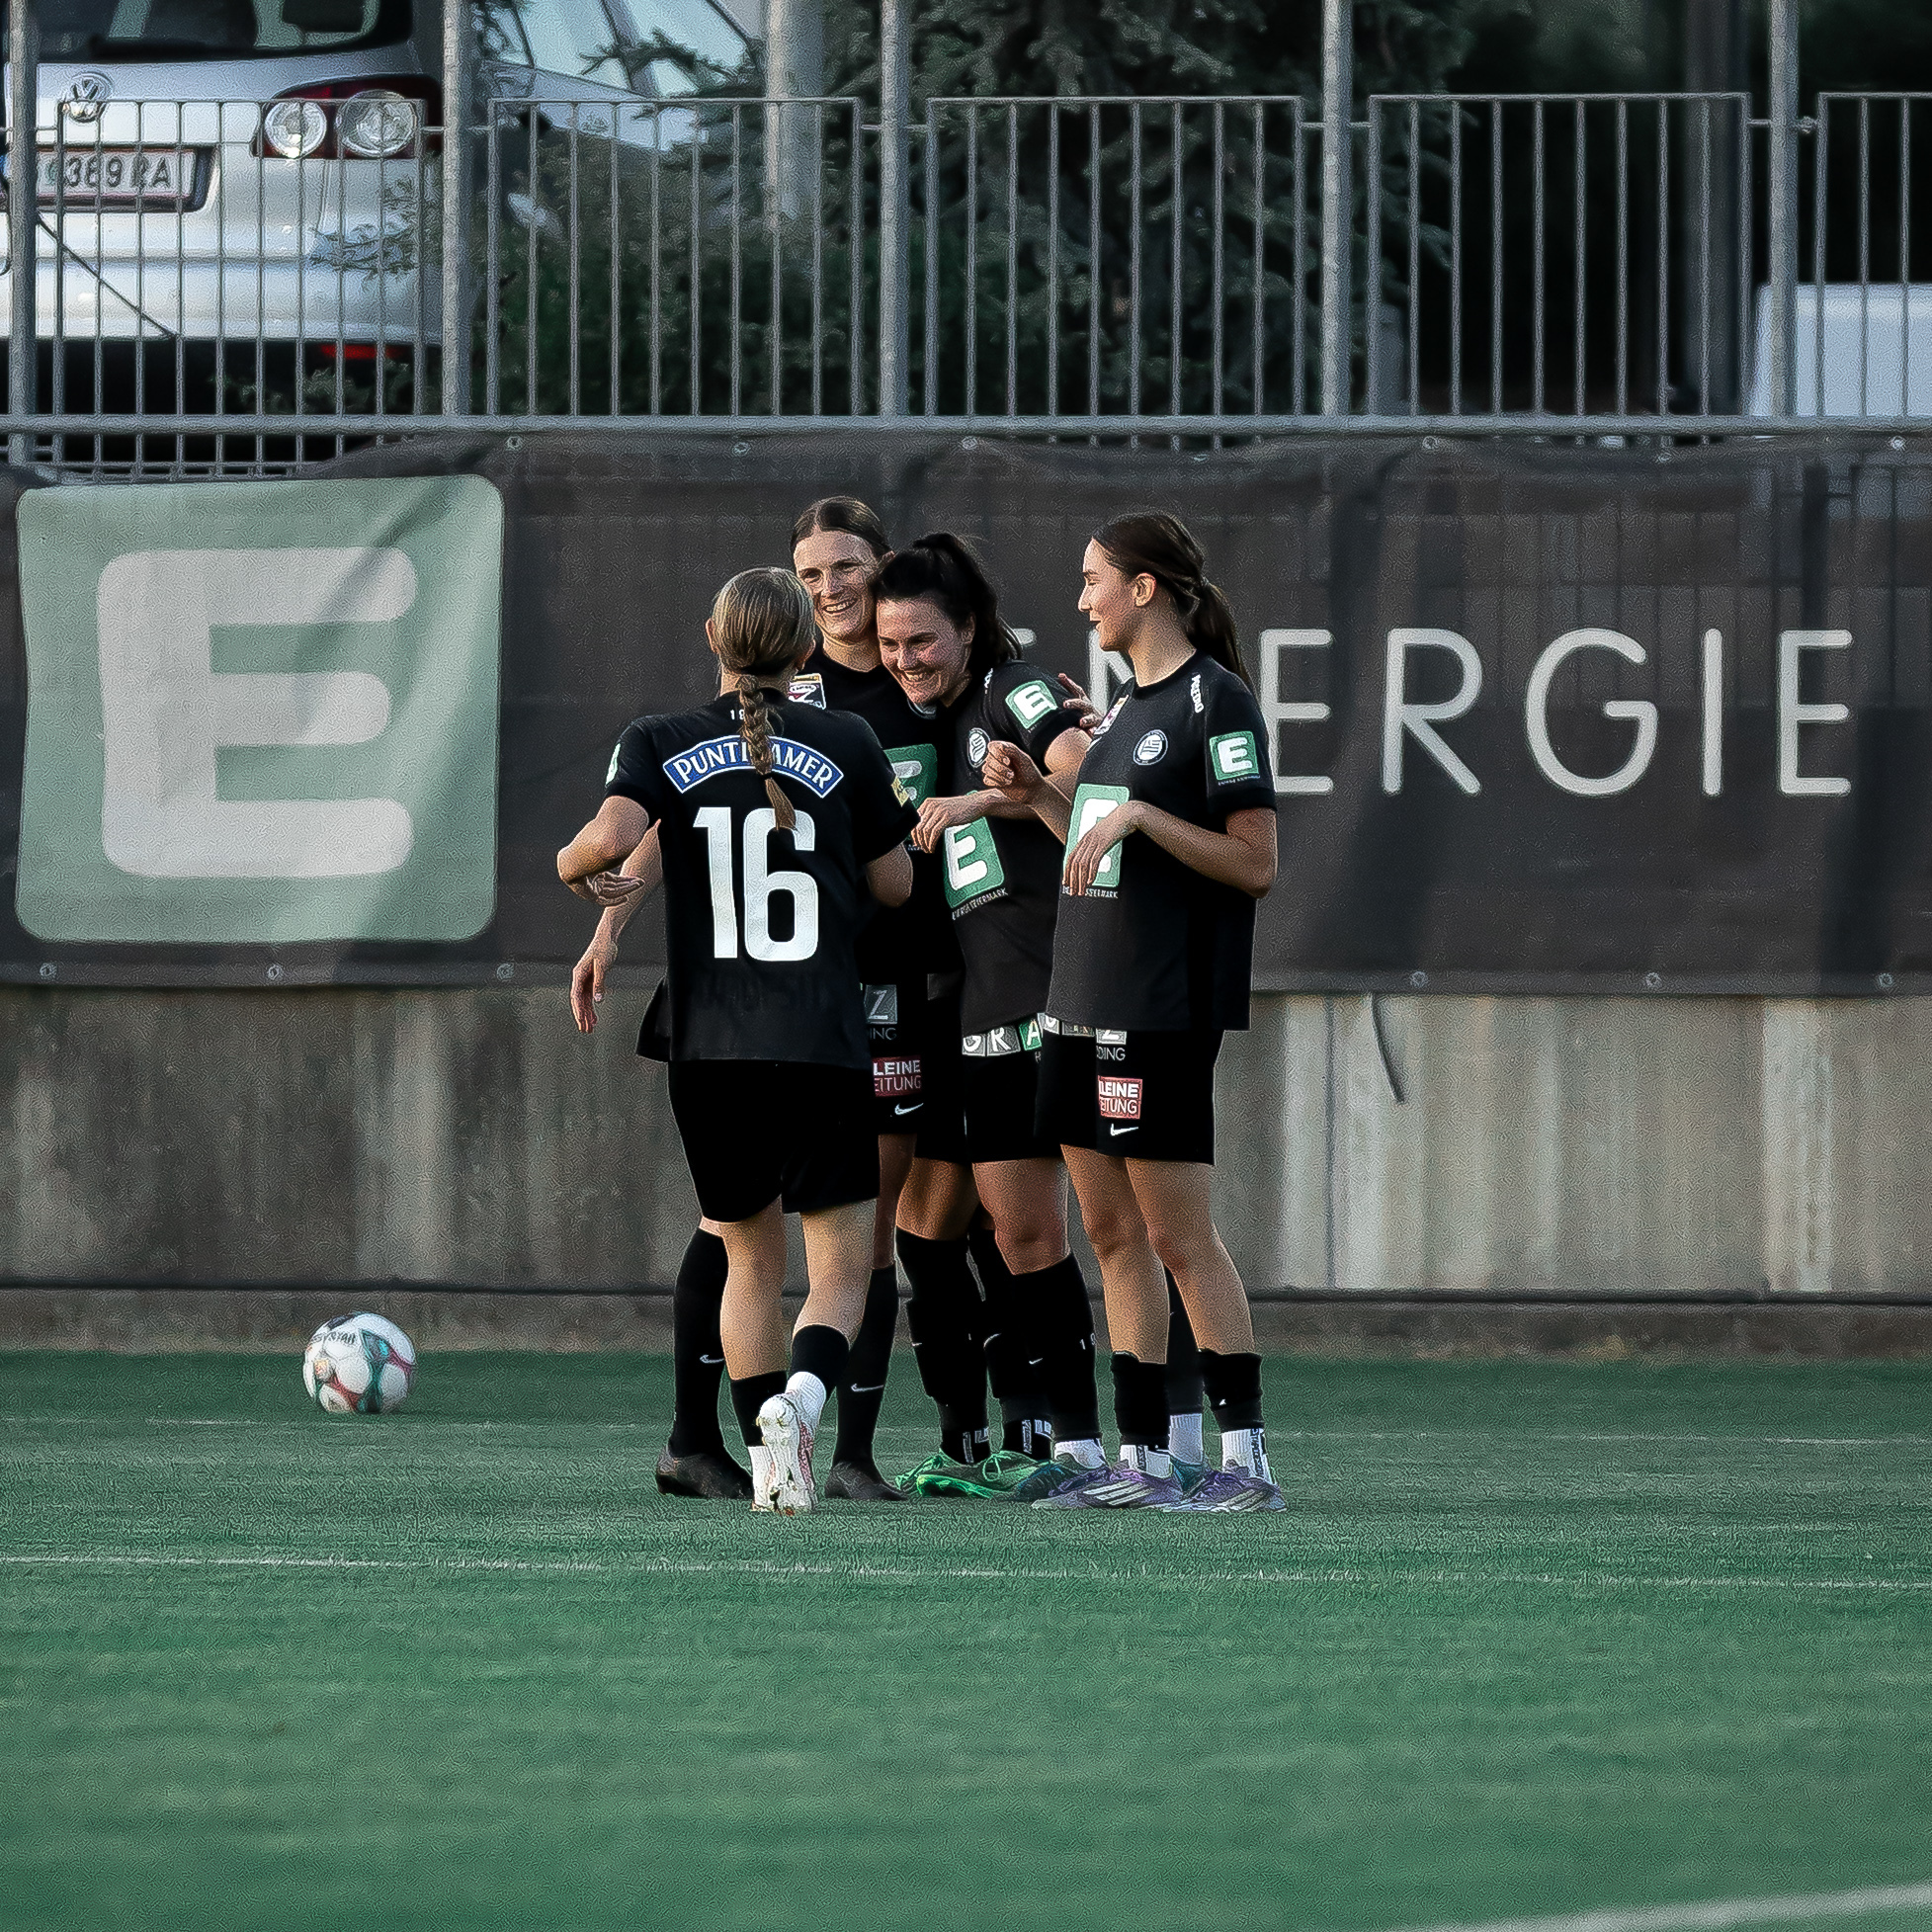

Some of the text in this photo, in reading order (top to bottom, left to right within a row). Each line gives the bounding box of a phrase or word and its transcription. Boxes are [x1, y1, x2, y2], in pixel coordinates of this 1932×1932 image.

[97, 546, 417, 879] E
[1016, 627, 1853, 797] ERGIE
[673, 741, 833, 790] PUNTIAMER
[1218, 736, 1253, 774] E
[693, 806, 819, 962] 16
[870, 1027, 897, 1041] ING
[963, 1018, 1043, 1052] GRA
[873, 1059, 921, 1076] LEINE
[1096, 1047, 1126, 1061] DING
[874, 1074, 922, 1092] EITUNG
[1098, 1080, 1139, 1098] LEINE
